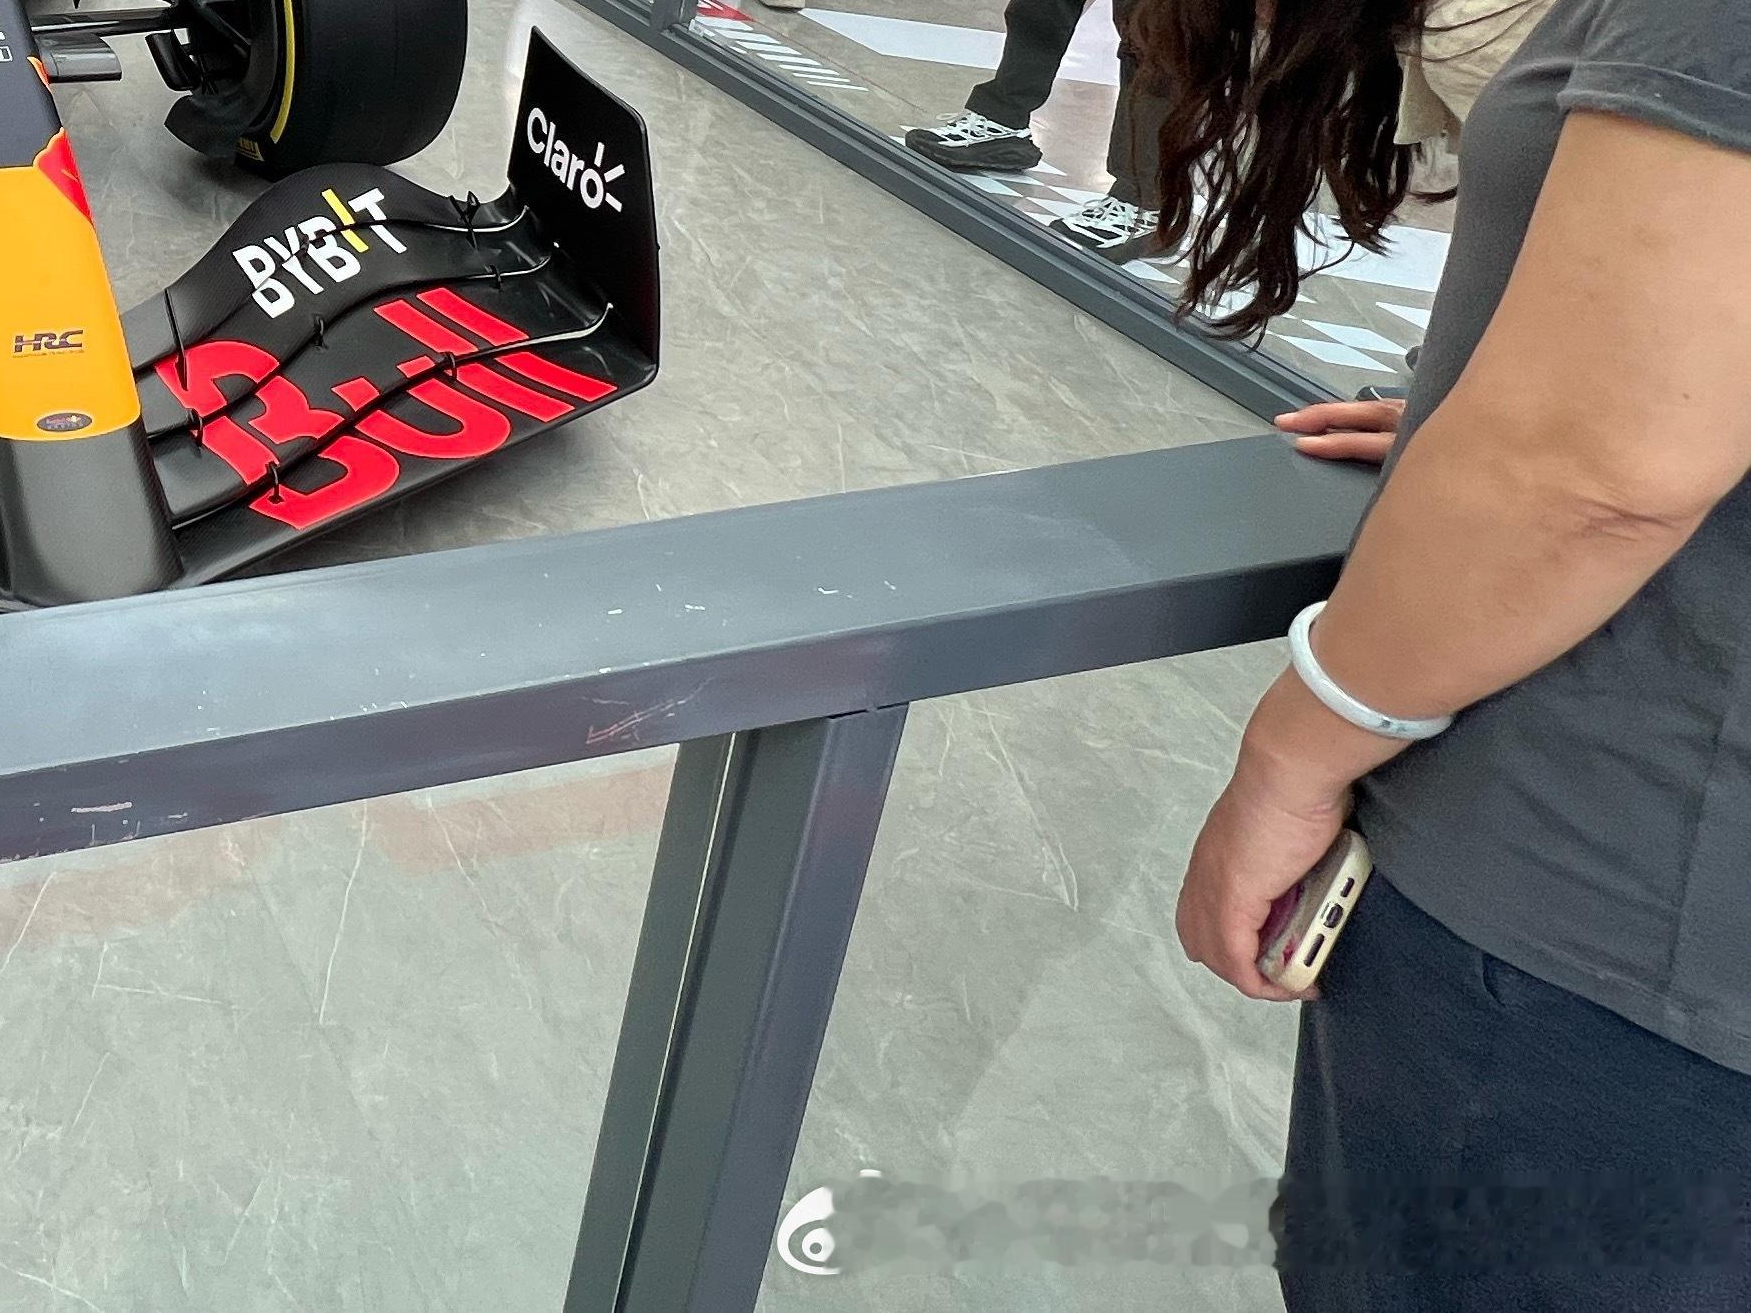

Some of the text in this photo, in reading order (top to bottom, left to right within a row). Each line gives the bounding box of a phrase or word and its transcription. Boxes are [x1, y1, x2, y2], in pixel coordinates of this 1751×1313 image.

[527, 107, 609, 209] Claro
[232, 188, 408, 319] BYBIT
[14, 329, 84, 353] HRC
[154, 287, 619, 531] Bull
